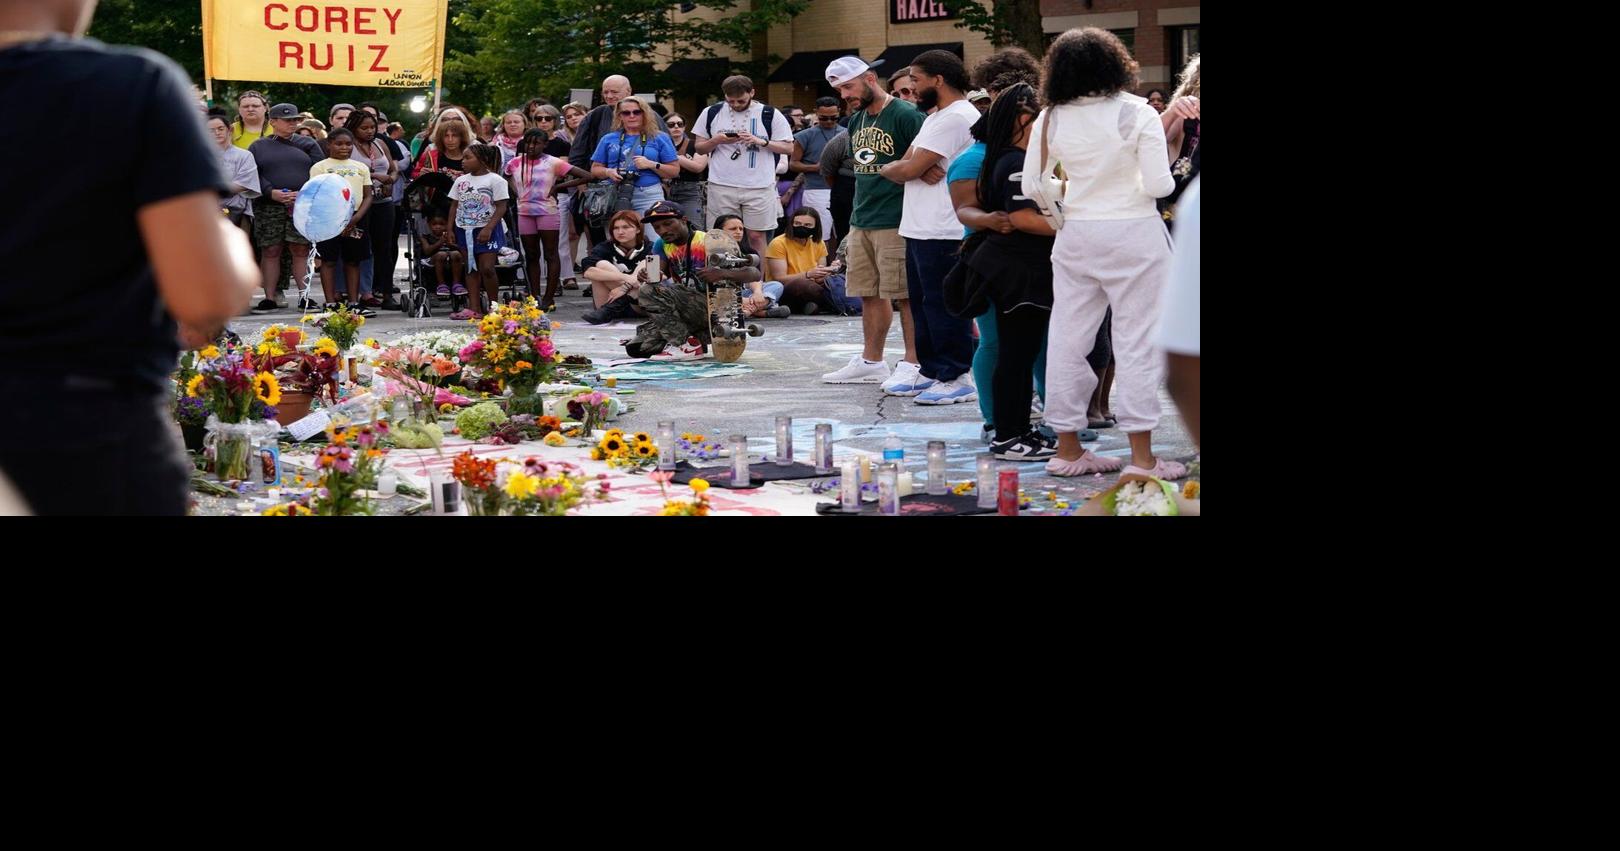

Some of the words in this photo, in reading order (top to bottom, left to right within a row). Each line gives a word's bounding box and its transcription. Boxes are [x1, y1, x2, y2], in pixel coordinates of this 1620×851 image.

[264, 3, 402, 35] COREY
[278, 41, 390, 72] RUIZ
[378, 78, 405, 86] LABOR
[854, 147, 876, 165] G
